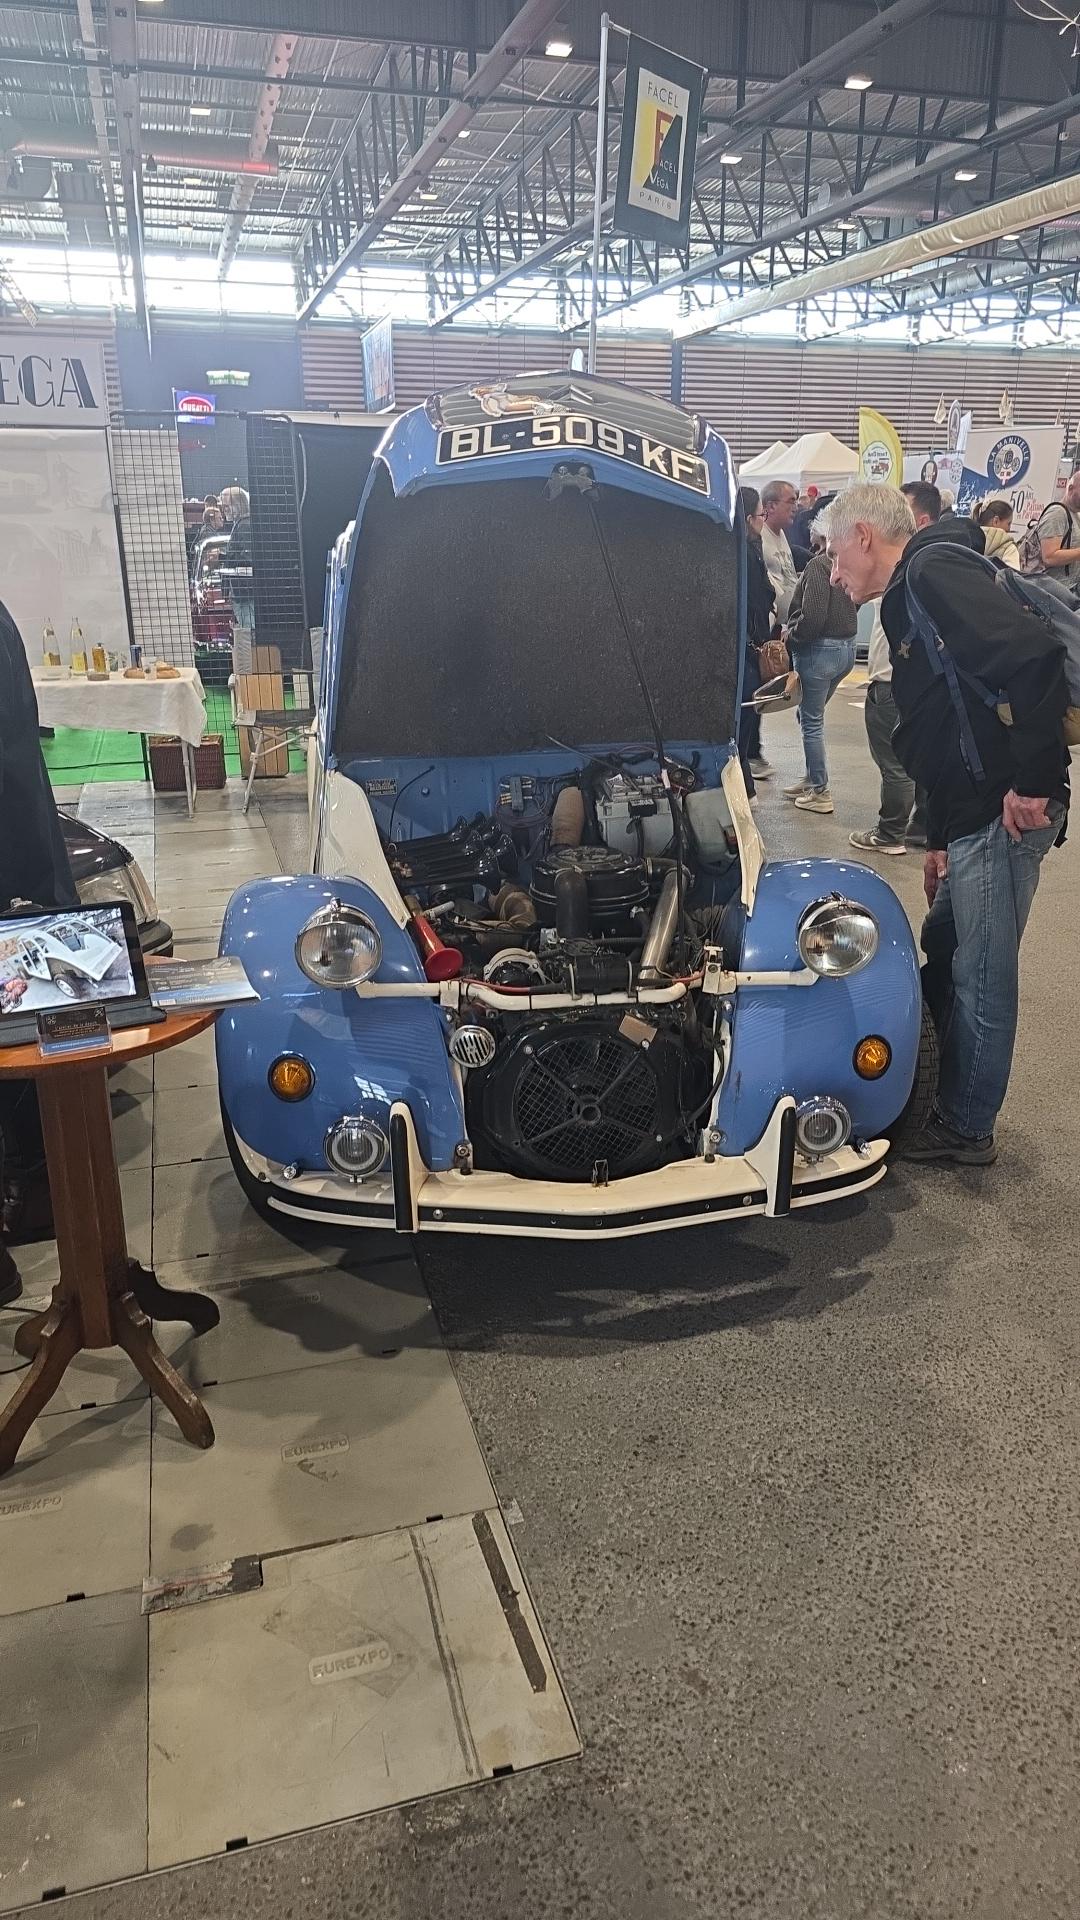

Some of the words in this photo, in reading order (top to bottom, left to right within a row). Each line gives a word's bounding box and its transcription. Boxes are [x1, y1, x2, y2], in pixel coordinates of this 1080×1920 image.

[647, 82, 679, 108] FACEL
[650, 169, 669, 190] VEGA
[639, 192, 672, 210] PARIS
[0, 354, 98, 409] EGA
[988, 451, 997, 463] LA
[997, 436, 1030, 462] MANIVELLE
[1010, 490, 1025, 514] 50
[312, 1647, 389, 1678] EUREXPO
